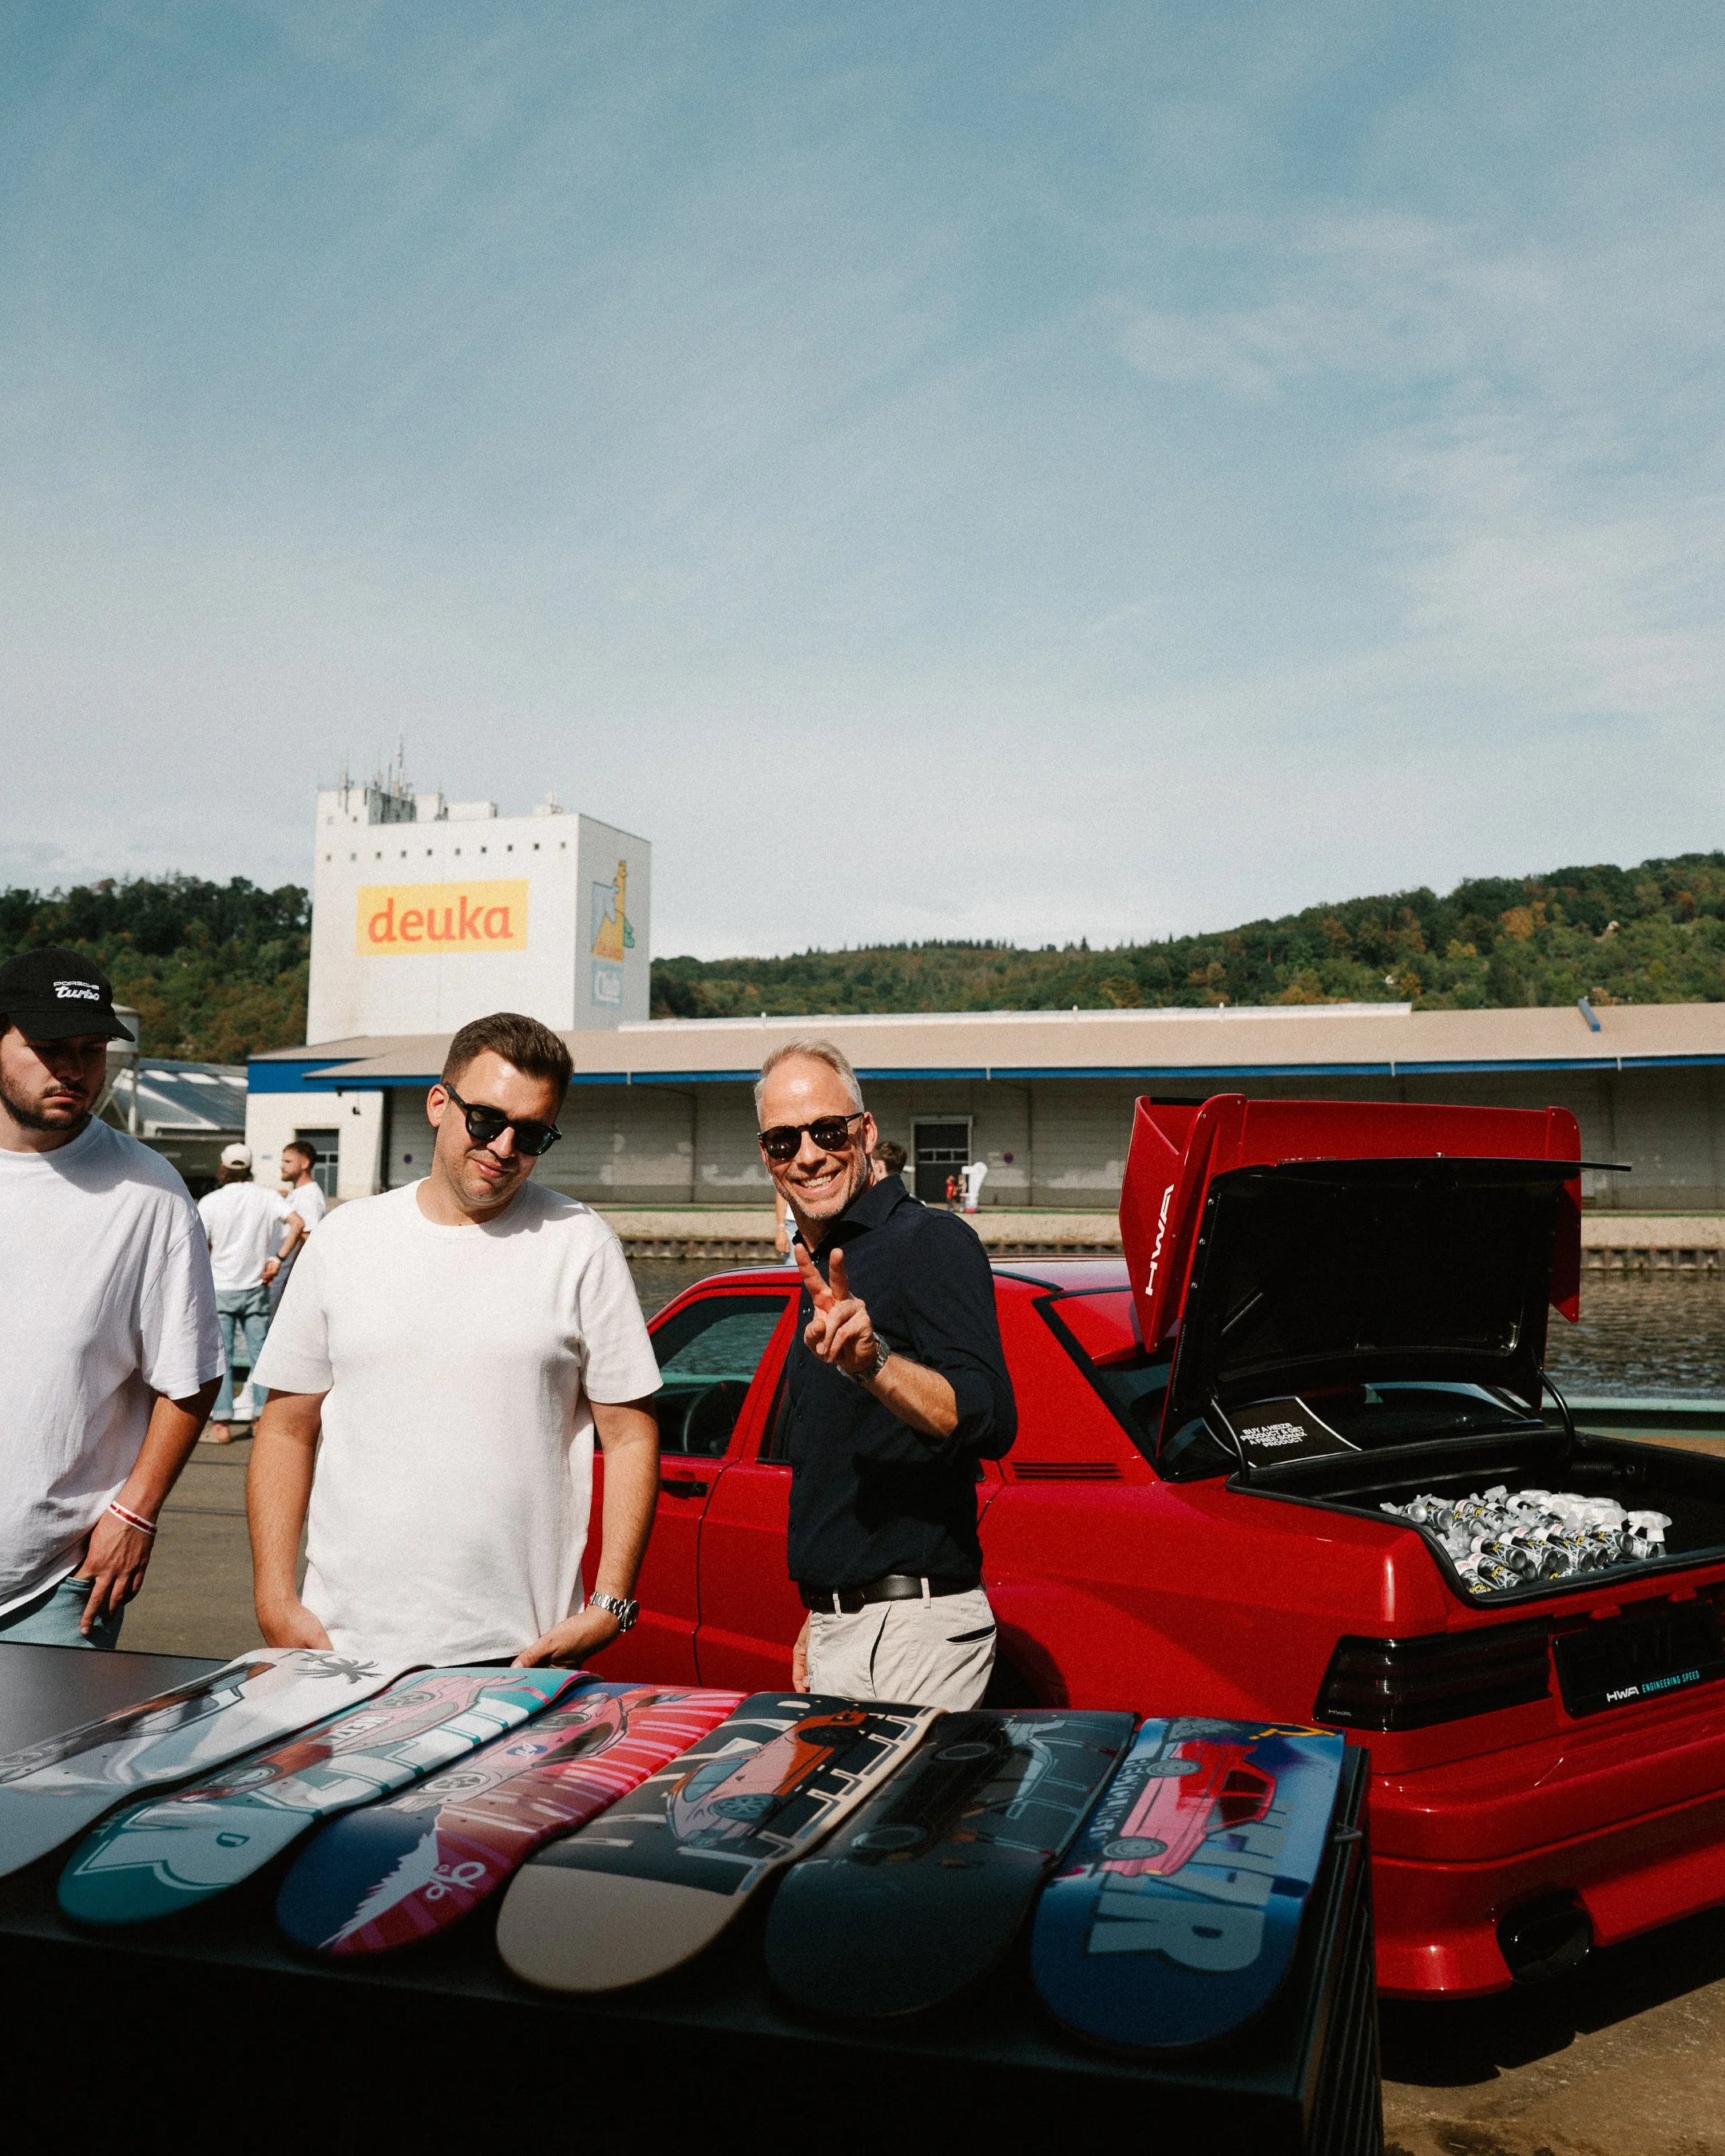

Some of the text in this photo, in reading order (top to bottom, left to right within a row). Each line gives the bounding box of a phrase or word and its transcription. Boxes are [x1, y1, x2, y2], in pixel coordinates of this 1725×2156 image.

[367, 895, 514, 943] deuka
[1144, 1183, 1175, 1296] HWA
[1239, 1430, 1280, 1441] PRODUCT
[1262, 1437, 1303, 1447] PRODUCT
[1606, 1670, 1699, 1702] HWA ENGINEERING SPEED
